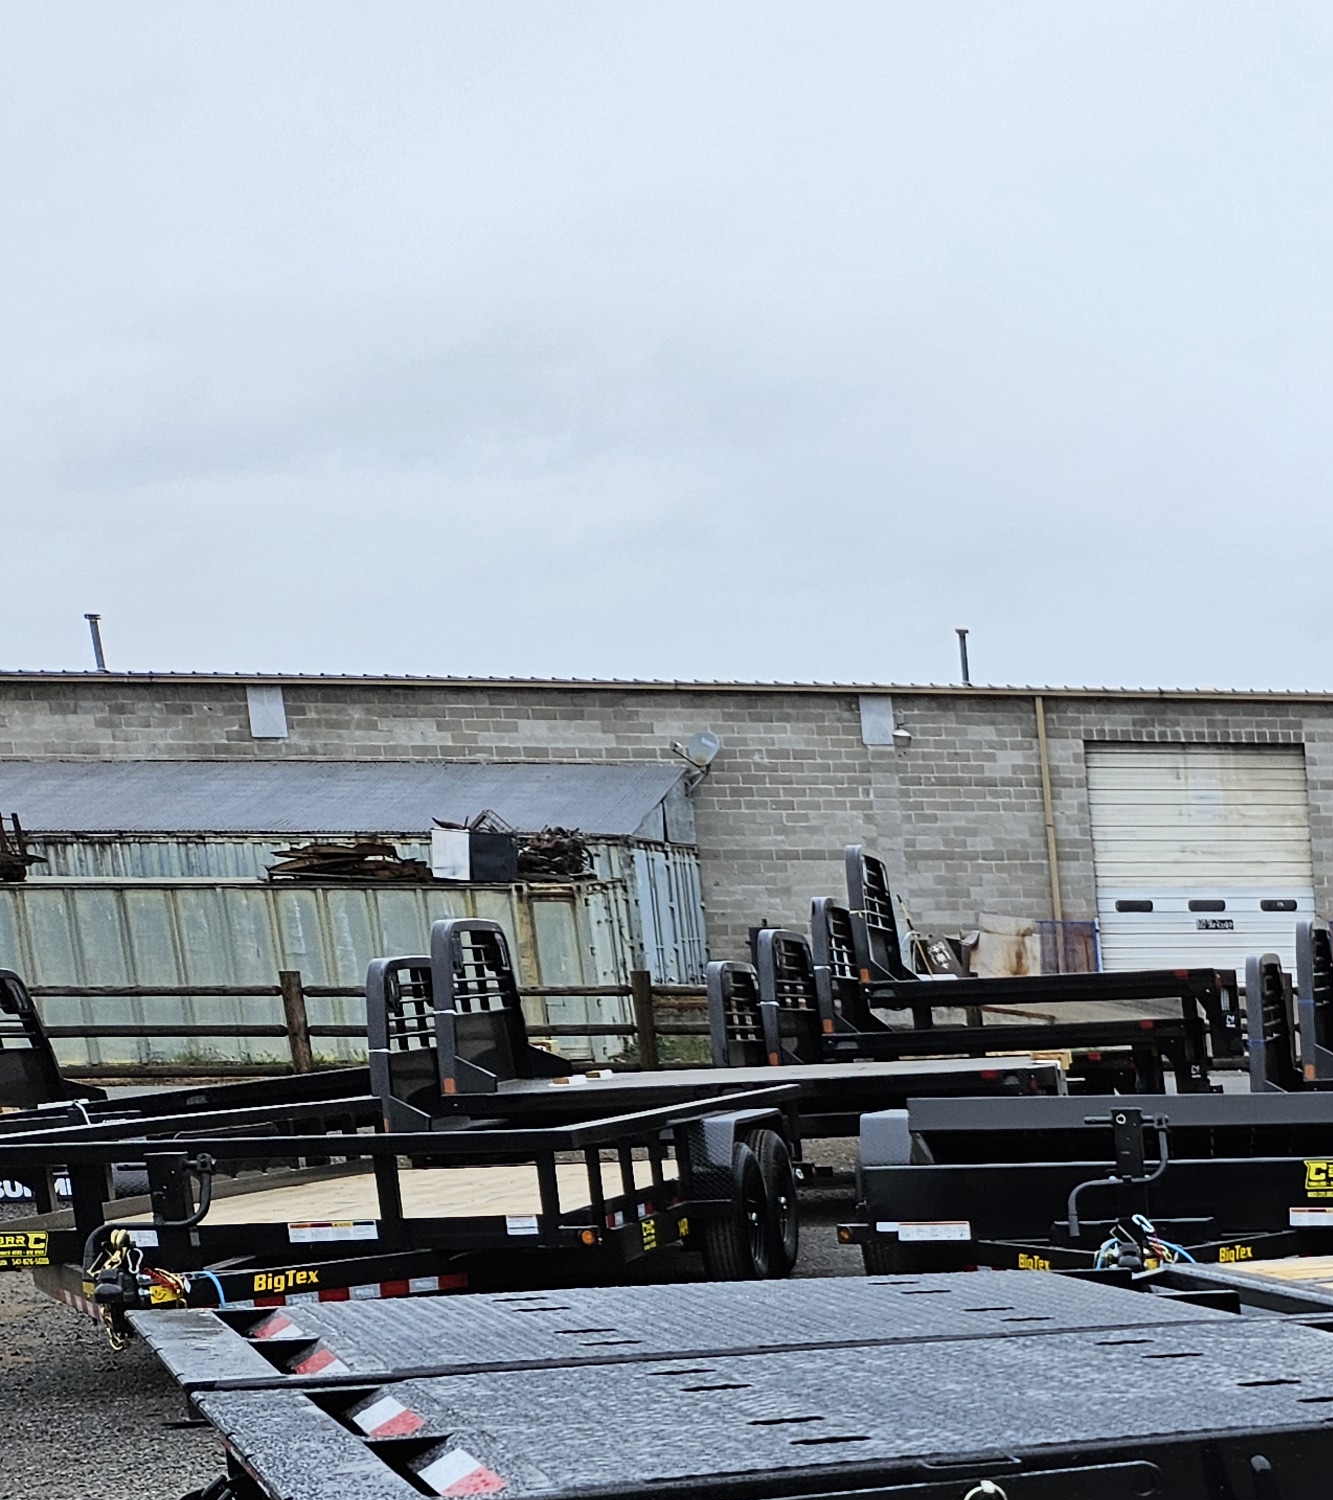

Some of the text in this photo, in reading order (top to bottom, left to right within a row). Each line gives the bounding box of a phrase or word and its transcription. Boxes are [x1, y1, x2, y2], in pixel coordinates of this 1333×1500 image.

[1018, 1253, 1050, 1271] BigTex
[1219, 1244, 1253, 1263] BigTex
[254, 1270, 319, 1292] BigTex
